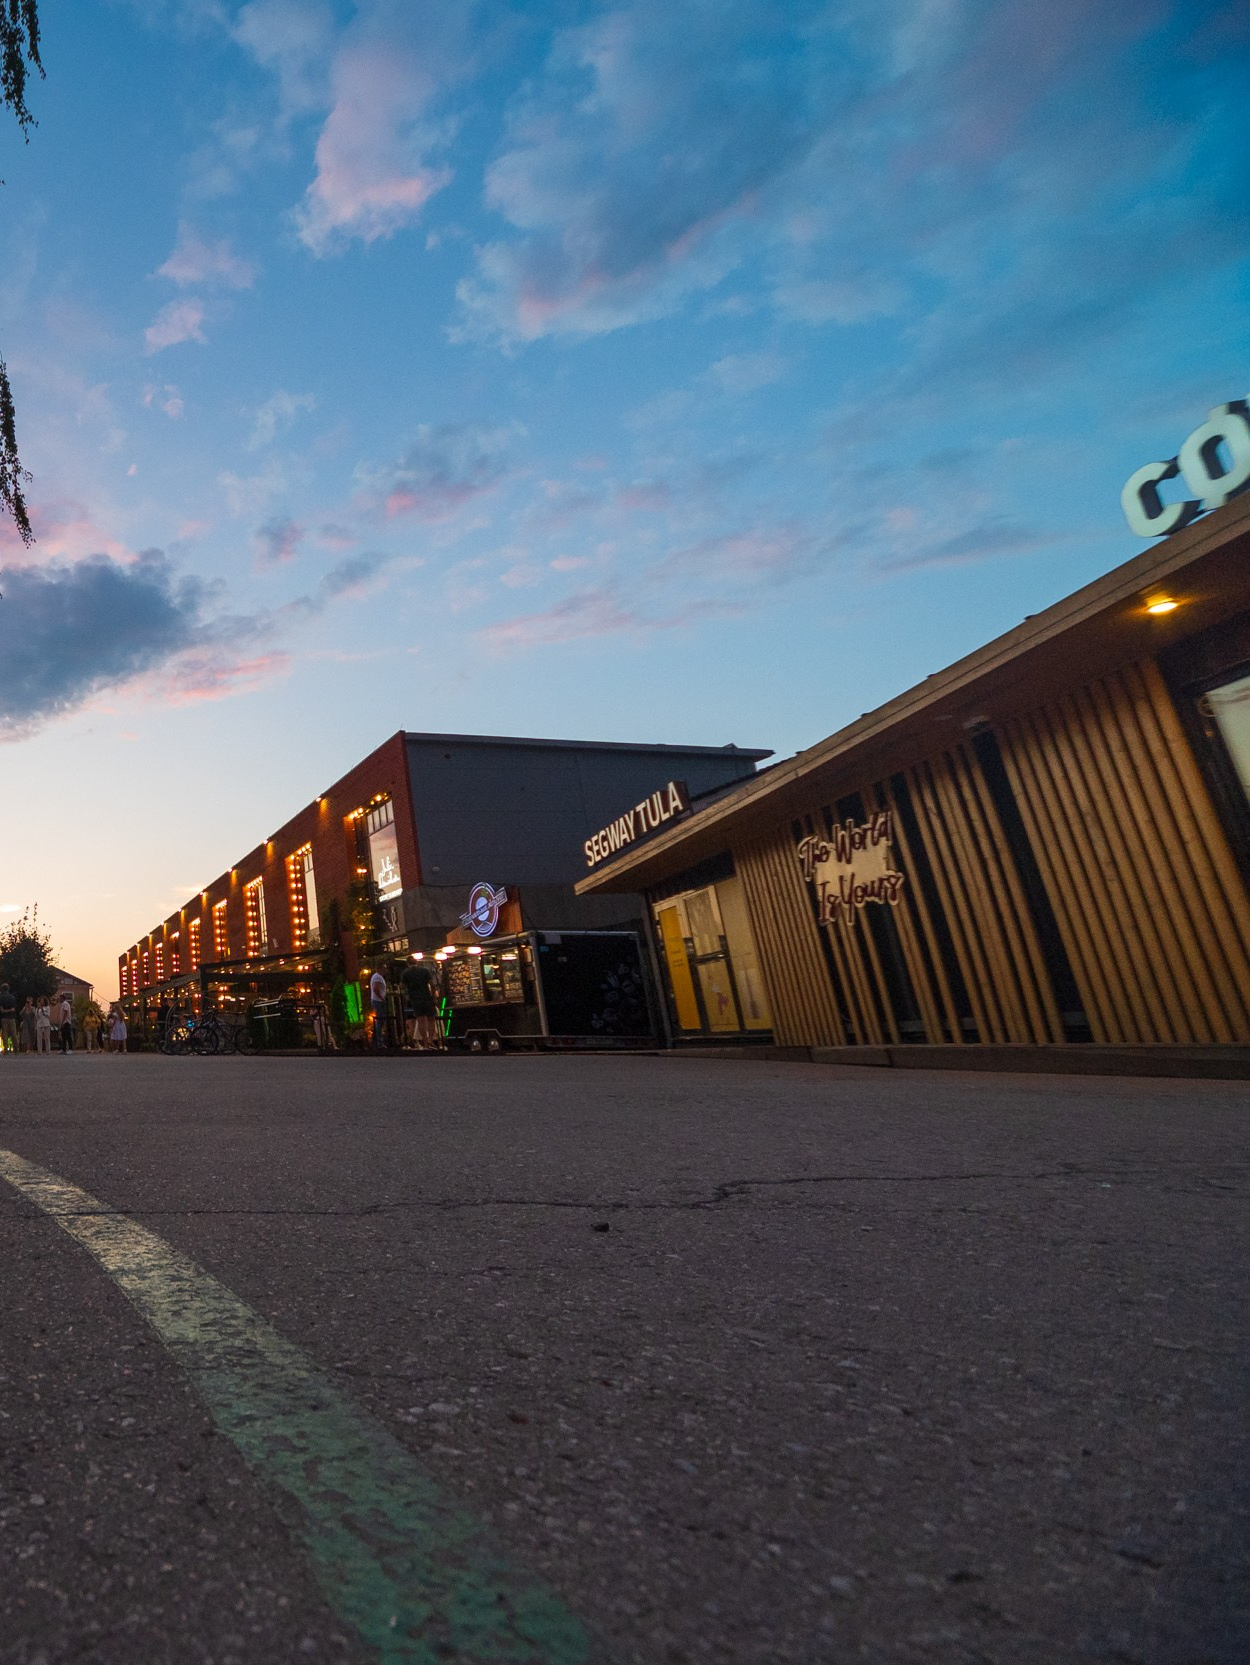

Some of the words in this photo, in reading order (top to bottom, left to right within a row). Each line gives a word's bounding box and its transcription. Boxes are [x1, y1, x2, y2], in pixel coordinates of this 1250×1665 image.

[585, 810, 635, 867] SEGWAY
[635, 781, 684, 832] TULA
[798, 836, 831, 881] The
[833, 811, 892, 864] World
[816, 881, 840, 925] Is
[838, 869, 904, 925] Yours
